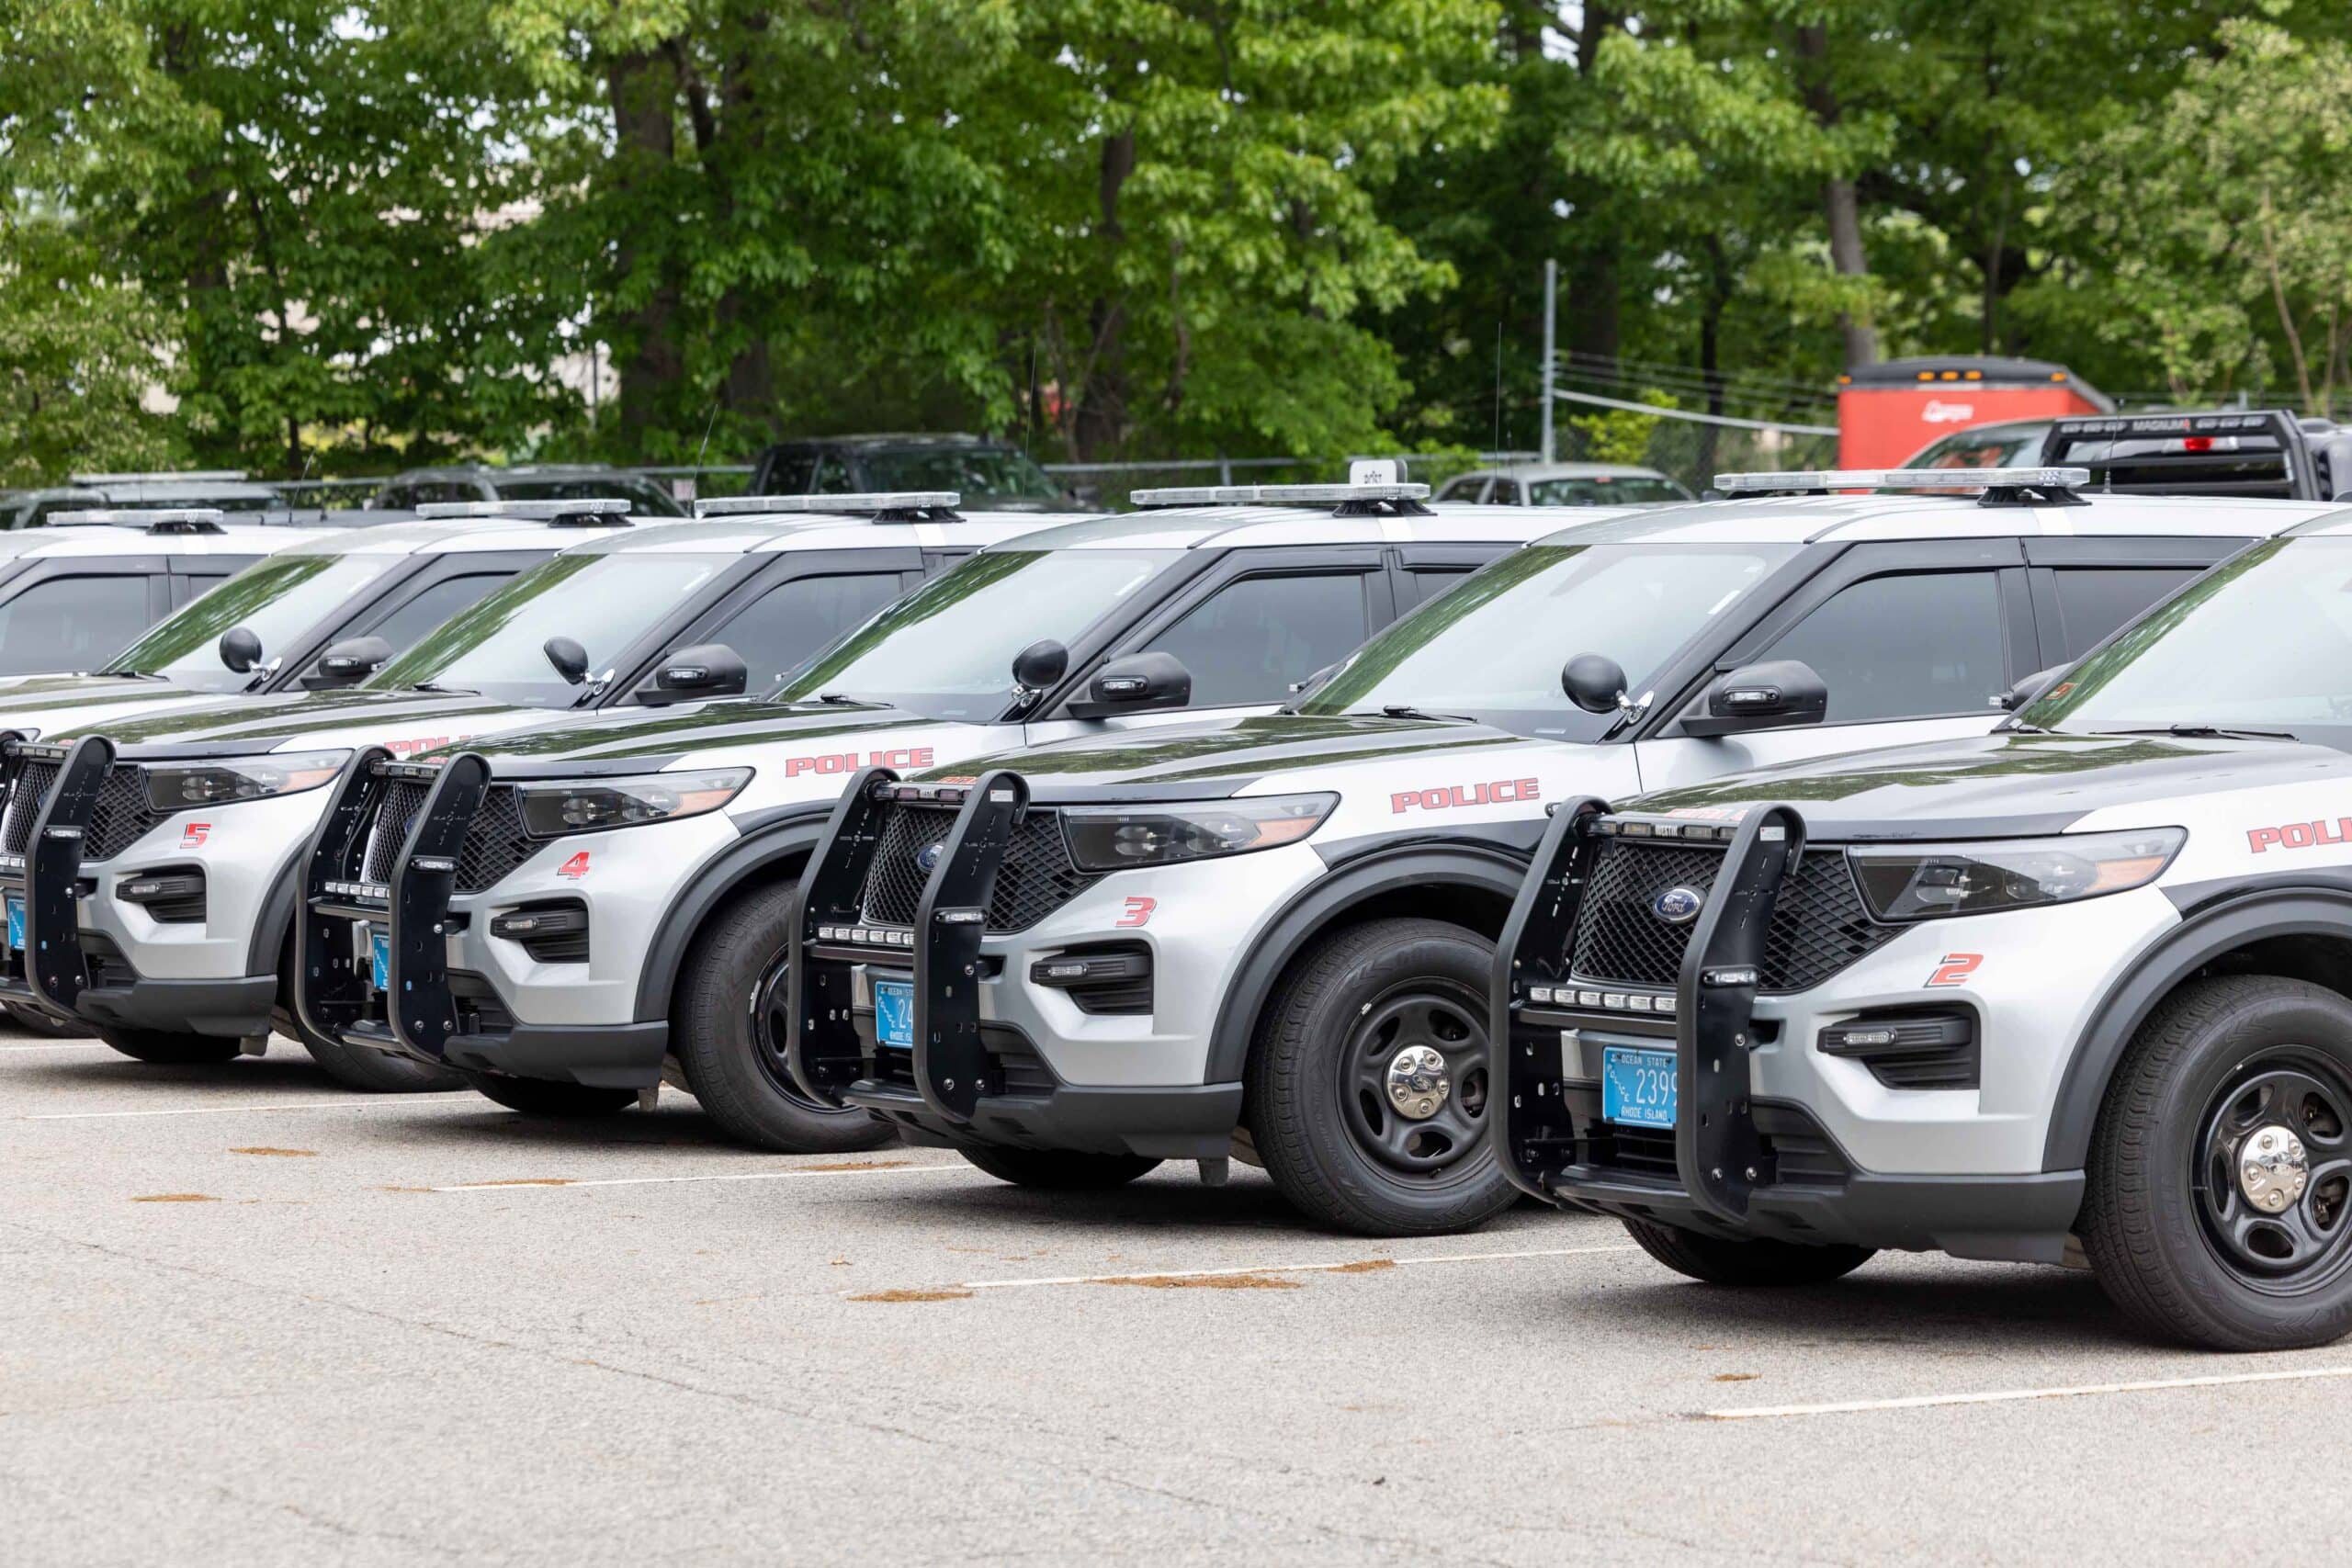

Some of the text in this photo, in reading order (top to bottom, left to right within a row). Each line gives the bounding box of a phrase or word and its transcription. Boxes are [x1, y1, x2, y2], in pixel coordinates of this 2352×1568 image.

[786, 748, 933, 778] POLICE
[1390, 777, 1540, 814] POLICE
[179, 823, 211, 849] 5
[2246, 817, 2352, 853] POLI
[557, 852, 590, 880] 4
[1114, 896, 1158, 928] 3
[1662, 894, 1687, 914] Ford
[1923, 953, 1984, 988] 2
[899, 998, 913, 1030] 24
[1621, 1054, 1668, 1067] OCEAN STATE
[1607, 1063, 1631, 1103] POLICE
[1621, 1106, 1668, 1121] RHODE ISLAND
